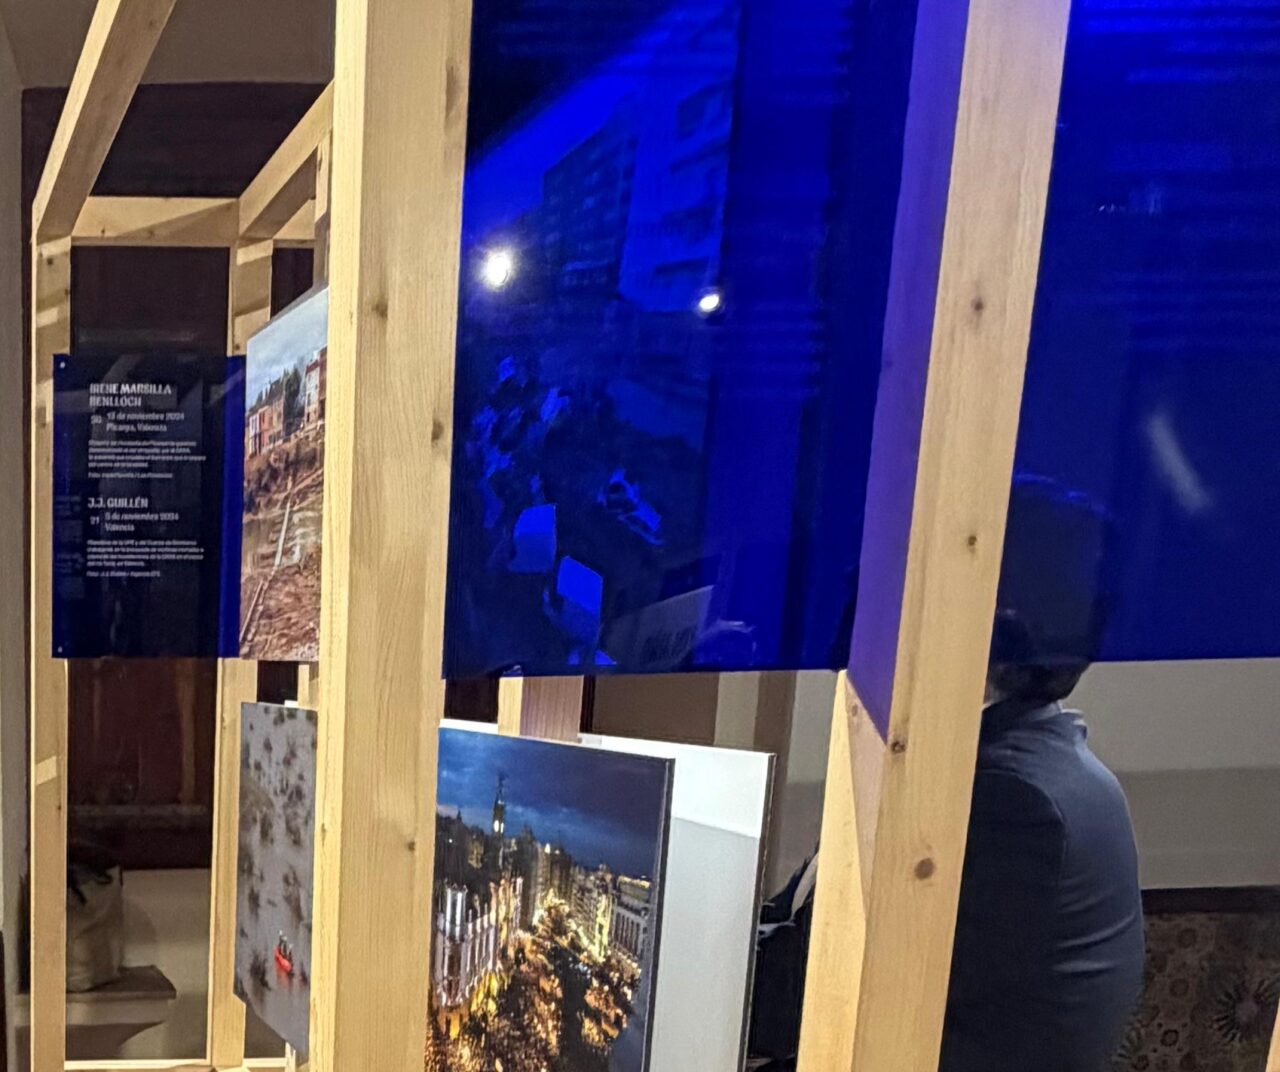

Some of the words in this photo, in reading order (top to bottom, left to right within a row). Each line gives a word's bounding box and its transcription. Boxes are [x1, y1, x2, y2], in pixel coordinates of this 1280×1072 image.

[89, 383, 119, 394] IRENE
[120, 383, 172, 394] MARSILLA
[106, 496, 149, 508] GUILLÉN
